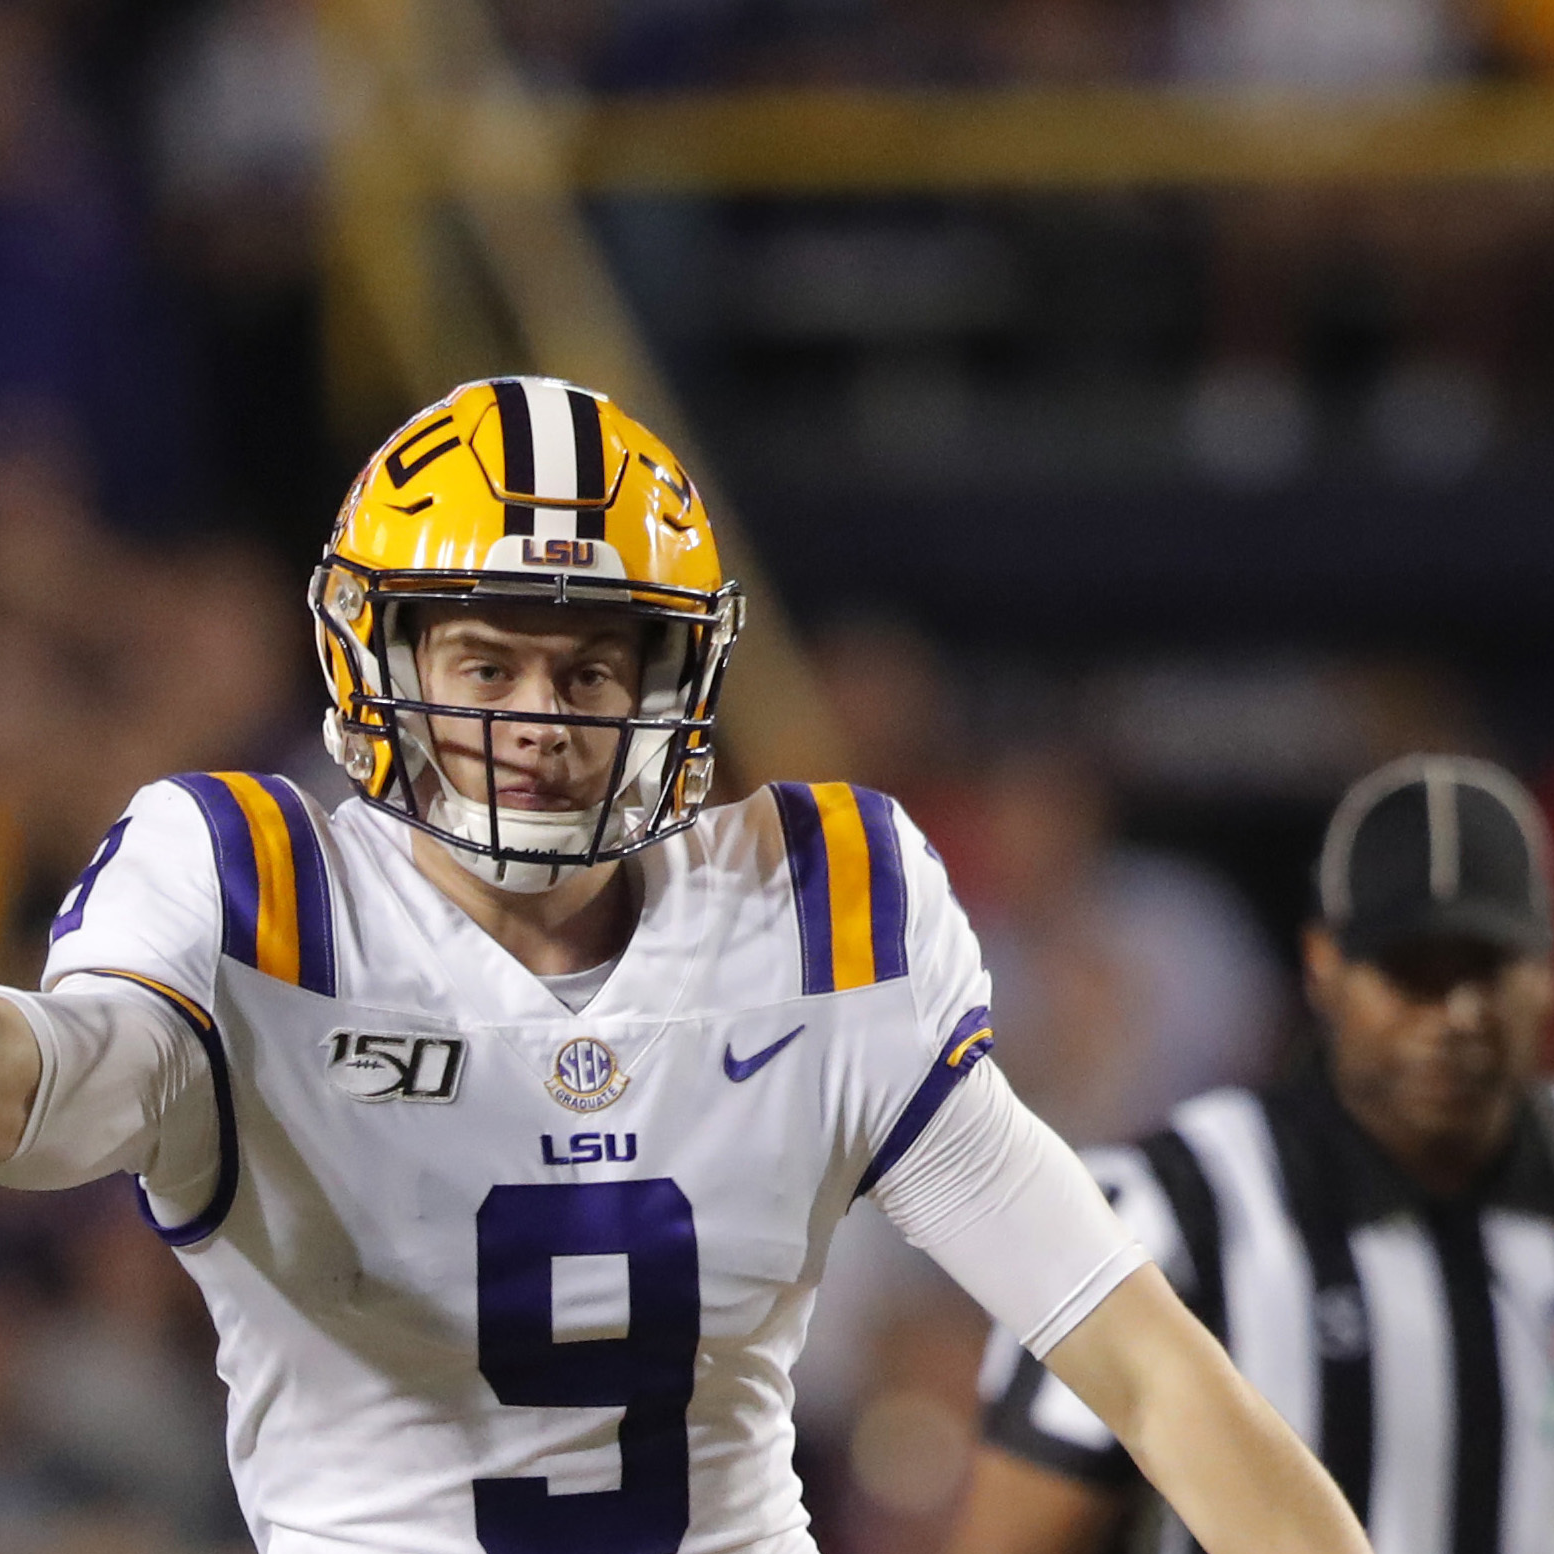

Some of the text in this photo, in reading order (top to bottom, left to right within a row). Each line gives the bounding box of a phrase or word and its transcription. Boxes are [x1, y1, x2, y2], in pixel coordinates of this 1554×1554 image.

[522, 538, 595, 567] LSU
[324, 1032, 464, 1099] 150
[559, 1041, 610, 1092] SEC
[555, 1085, 619, 1109] GRADUATE
[540, 1132, 637, 1165] LSU
